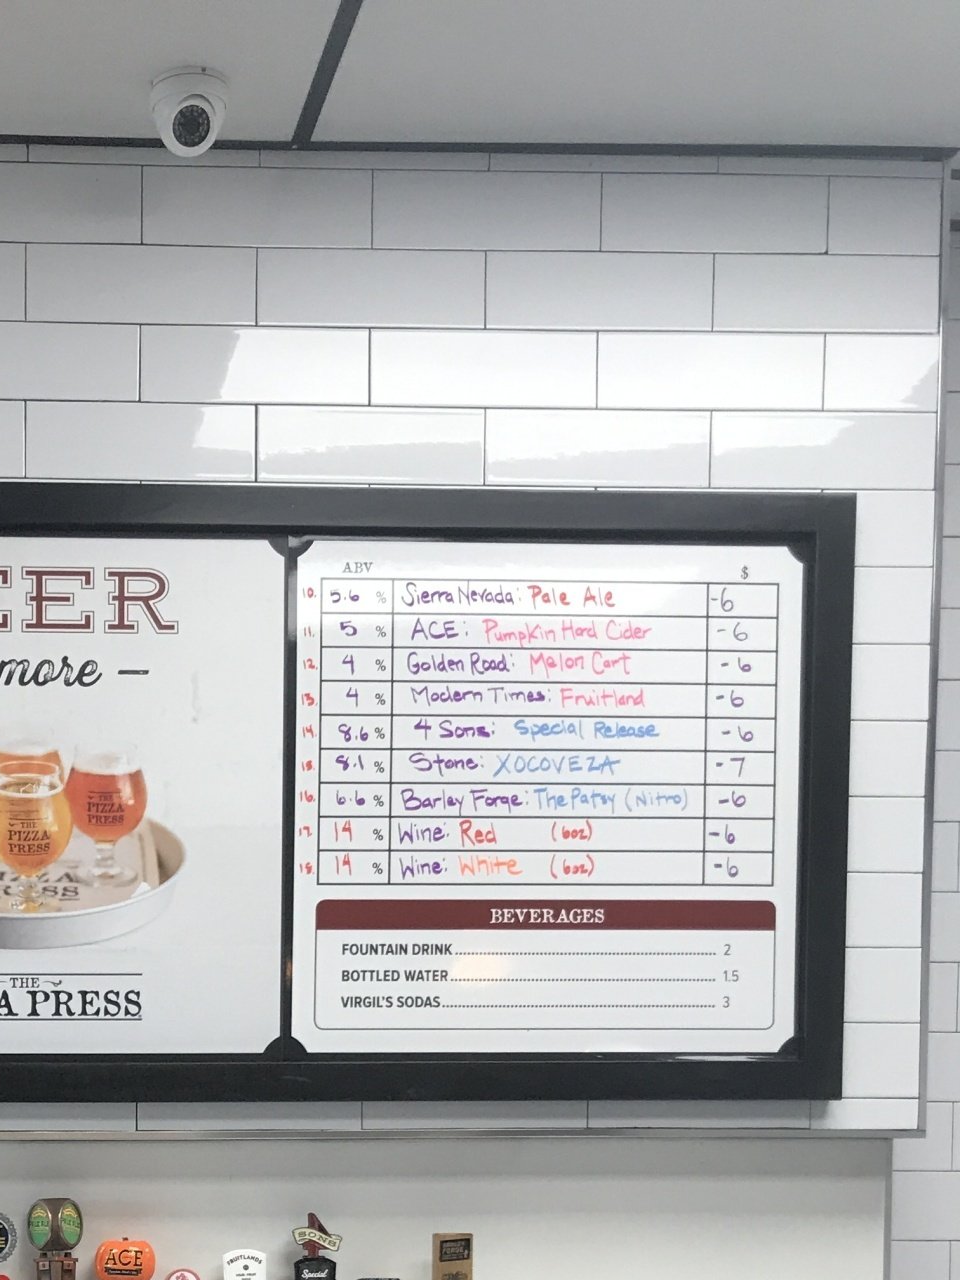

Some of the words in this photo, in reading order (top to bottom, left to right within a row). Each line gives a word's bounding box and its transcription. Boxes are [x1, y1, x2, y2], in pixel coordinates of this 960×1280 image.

[342, 562, 373, 574] ABV
[741, 566, 749, 580] $
[401, 582, 454, 607] Sierra
[527, 585, 570, 609] Pale
[583, 586, 616, 608] Ale
[411, 618, 469, 642] ACE:
[561, 619, 598, 641] Hard
[605, 620, 652, 641] Cider
[406, 651, 464, 676] Golden
[529, 653, 585, 679] Melon
[591, 651, 631, 675] Cart
[410, 686, 483, 710] Modern
[560, 687, 646, 708] Fruitland
[413, 718, 432, 741] 4
[514, 719, 584, 743] Special
[594, 721, 660, 739] Release
[493, 753, 621, 778] XOCOVEZA
[87, 802, 125, 813] PIZZA
[400, 788, 465, 817] Barley
[533, 787, 567, 810] The
[571, 789, 616, 814] Patsy
[20, 821, 38, 829] THE
[87, 814, 125, 825] PRESS
[7, 830, 50, 842] PIZZA
[459, 819, 497, 847] Red
[8, 842, 51, 854] PRESS
[458, 855, 523, 876] White
[490, 908, 605, 924] BEVERAGES
[342, 943, 408, 956] FOUNTAIN
[412, 943, 453, 956] DRINK
[723, 943, 731, 956] 2
[9, 977, 40, 988] THE
[341, 970, 400, 982] BOTTLED
[404, 970, 448, 982] WATER
[723, 970, 740, 982] 1.5
[26, 989, 142, 1017] PRESS
[340, 996, 393, 1008] VIRGIL'S
[397, 996, 441, 1008] SODAS
[723, 996, 731, 1008] 3
[297, 1230, 337, 1247] SONS
[105, 1249, 143, 1266] ACE
[227, 1254, 262, 1266] FRUITLANDS
[301, 1268, 328, 1279] Special
